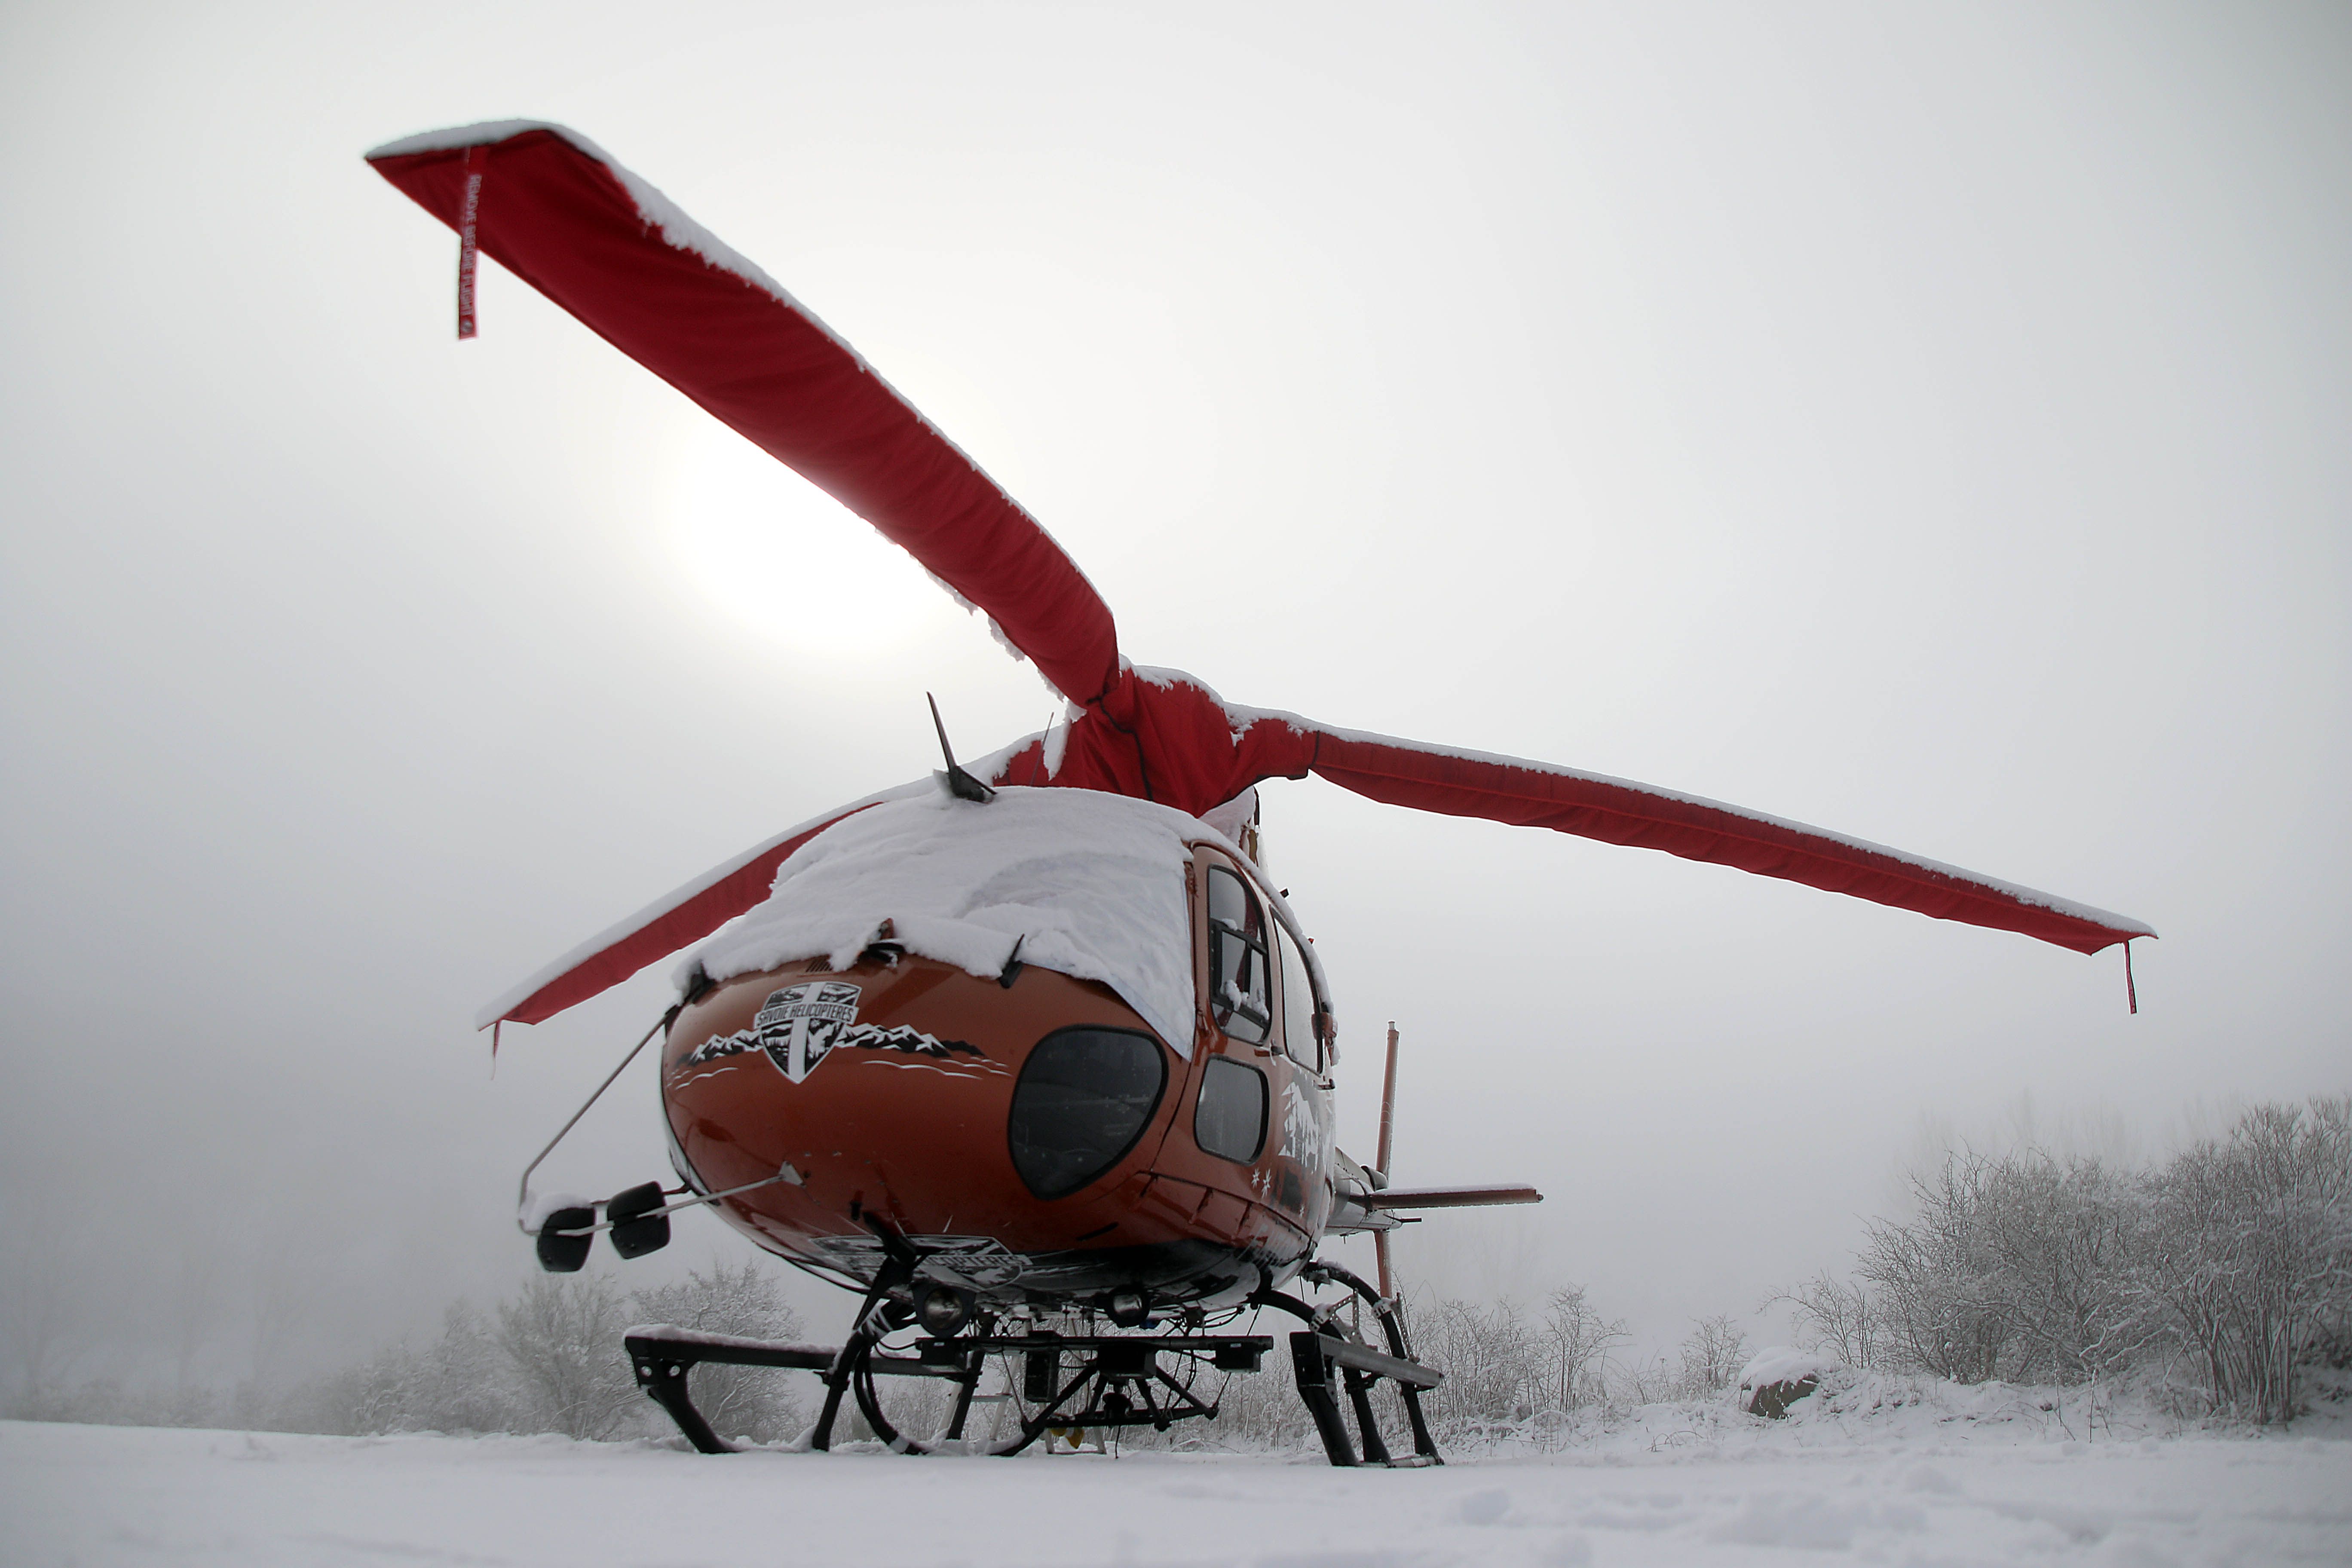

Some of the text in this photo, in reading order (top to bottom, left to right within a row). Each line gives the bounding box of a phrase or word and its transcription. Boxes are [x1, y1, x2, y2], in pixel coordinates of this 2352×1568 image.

[460, 175, 482, 316] REMOVE BEFORE FLIGHT
[757, 1004, 853, 1026] SAVOIE HELICOPTERES
